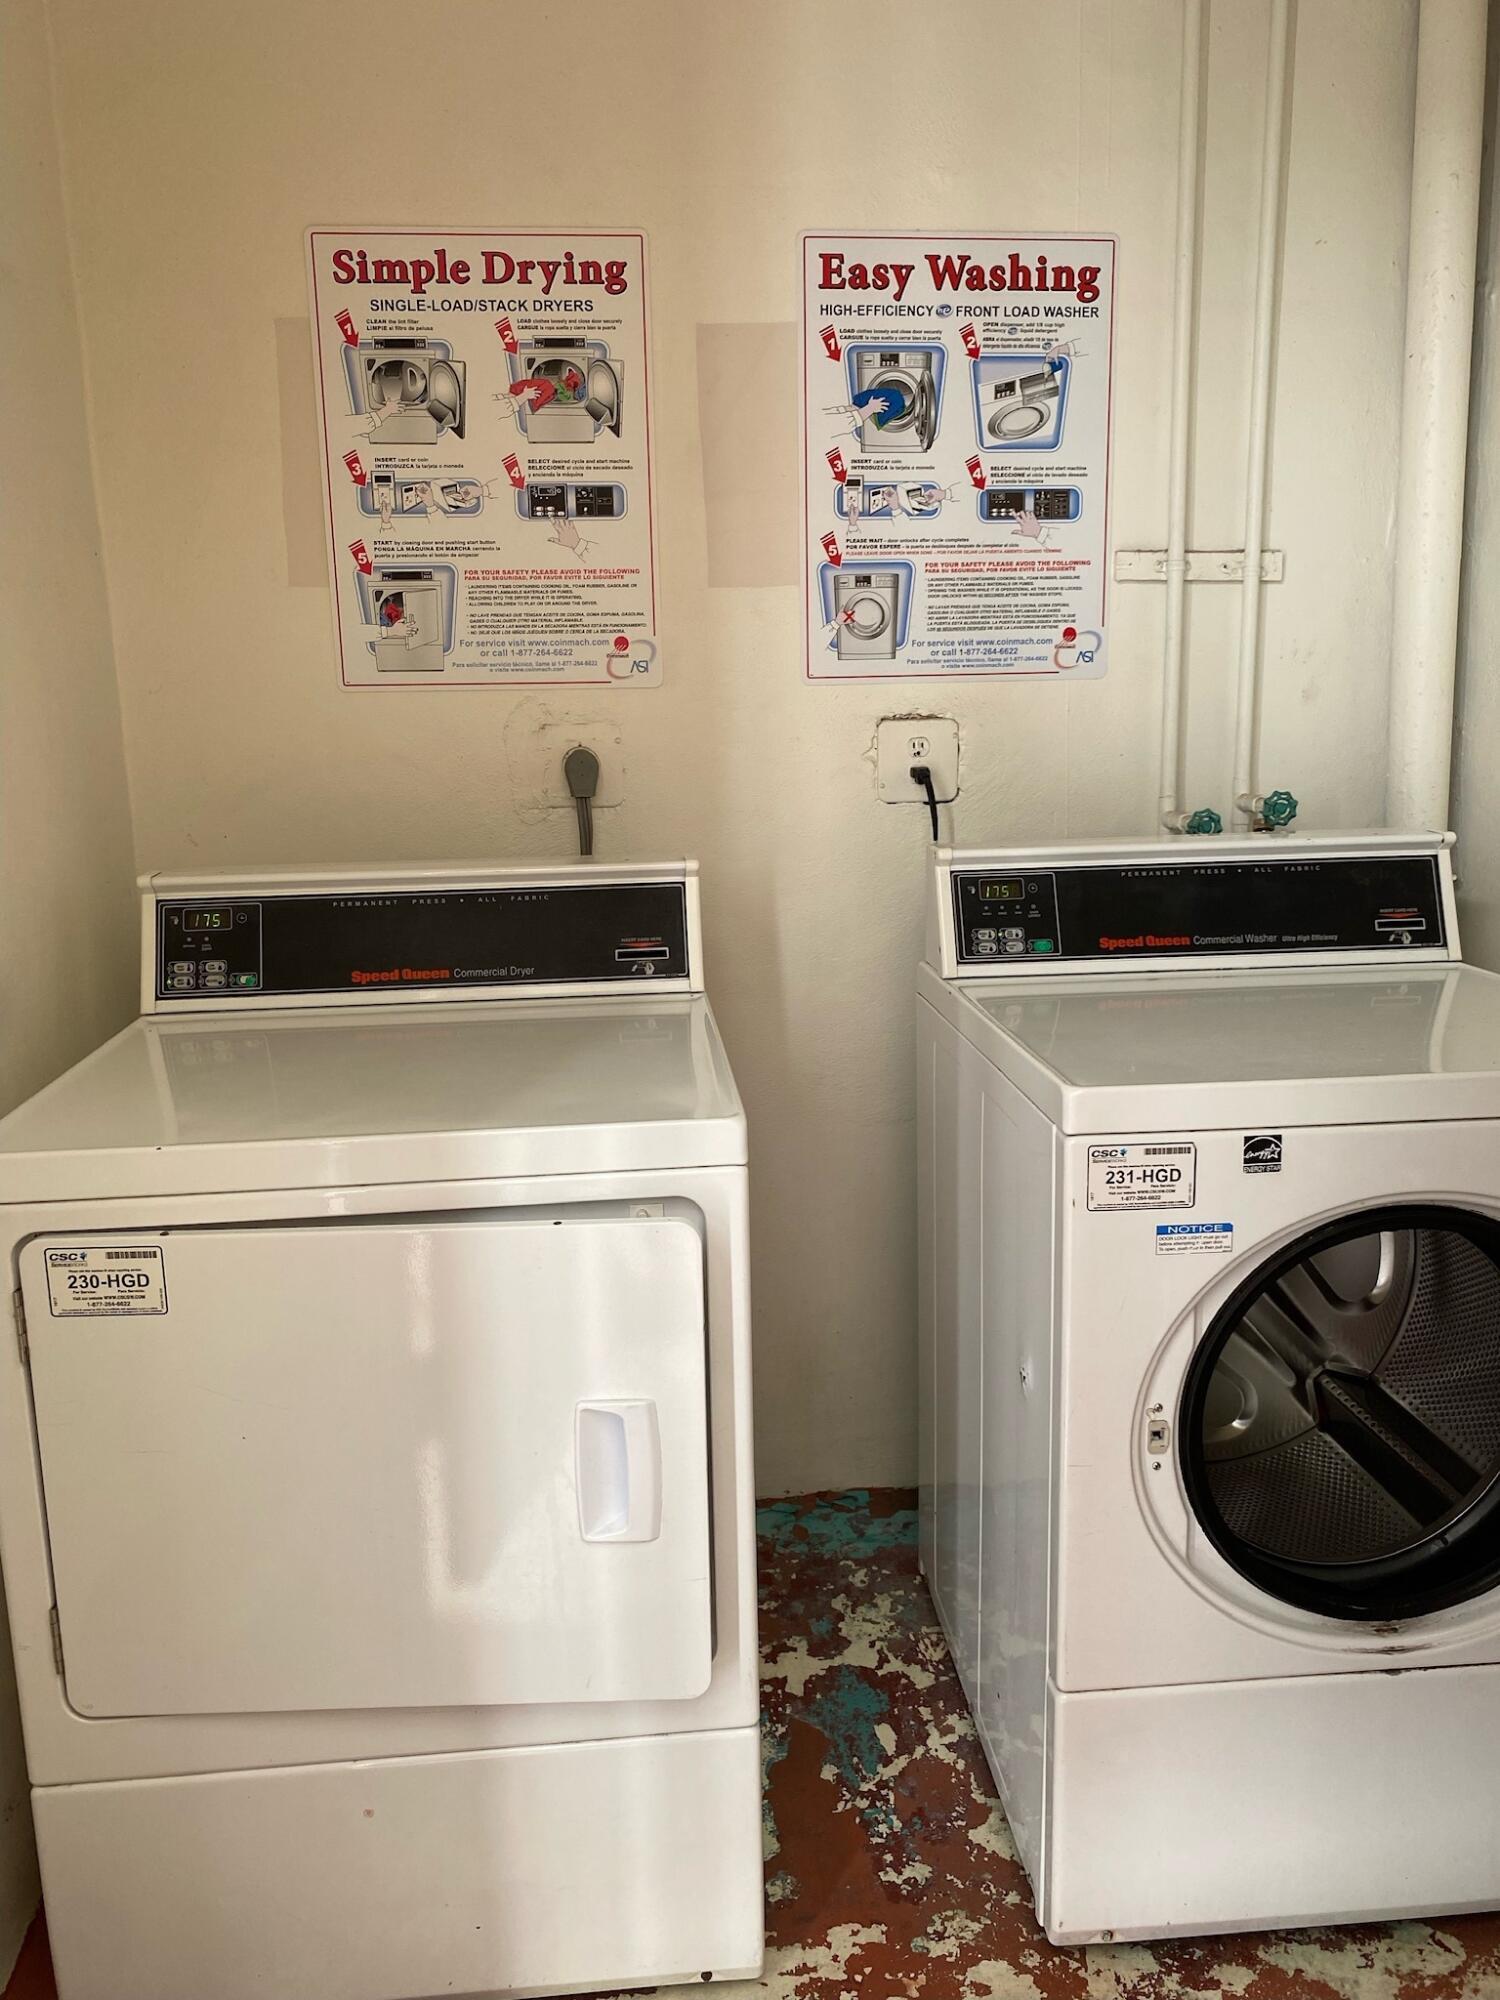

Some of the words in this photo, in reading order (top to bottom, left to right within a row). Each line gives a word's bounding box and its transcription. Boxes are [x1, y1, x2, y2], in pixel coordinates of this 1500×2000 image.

[332, 248, 470, 294] Simple
[481, 251, 628, 296] Drying
[818, 252, 915, 302] Easy
[924, 252, 1101, 303] Washing
[370, 299, 528, 312] SINGLE-LOAD/STACK
[533, 299, 594, 312] DRYERS
[821, 304, 934, 316] HIGH-EFFICIENCY
[956, 306, 1000, 317] FRONT
[1004, 306, 1040, 317] LOAD
[1044, 306, 1099, 317] WASHER
[342, 323, 353, 336] 1
[503, 330, 515, 344] 2
[827, 337, 836, 350] 1
[966, 336, 977, 349] 2
[352, 463, 362, 475] 3
[833, 461, 843, 472] 3
[510, 468, 521, 479] 4
[973, 468, 982, 479] 4
[828, 545, 838, 556] 5
[358, 552, 368, 564] 5
[528, 639, 610, 647] www.coinmach.com
[976, 638, 1053, 647] www.coinmach.com
[986, 885, 1009, 898] 175
[195, 914, 220, 927] 175
[1099, 936, 1144, 950] Speed
[1145, 935, 1190, 948] Queen
[1193, 934, 1244, 946] Commercial
[1245, 933, 1277, 944] Washer
[351, 969, 399, 984] Speed
[401, 968, 450, 981] Queen
[454, 967, 508, 978] Commercial
[510, 966, 535, 978] Dryer
[1092, 1149, 1118, 1157] CSC
[1106, 1168, 1182, 1184] 231-HGD
[1168, 1224, 1223, 1233] NOTICE
[67, 1274, 150, 1289] 230-HGD
